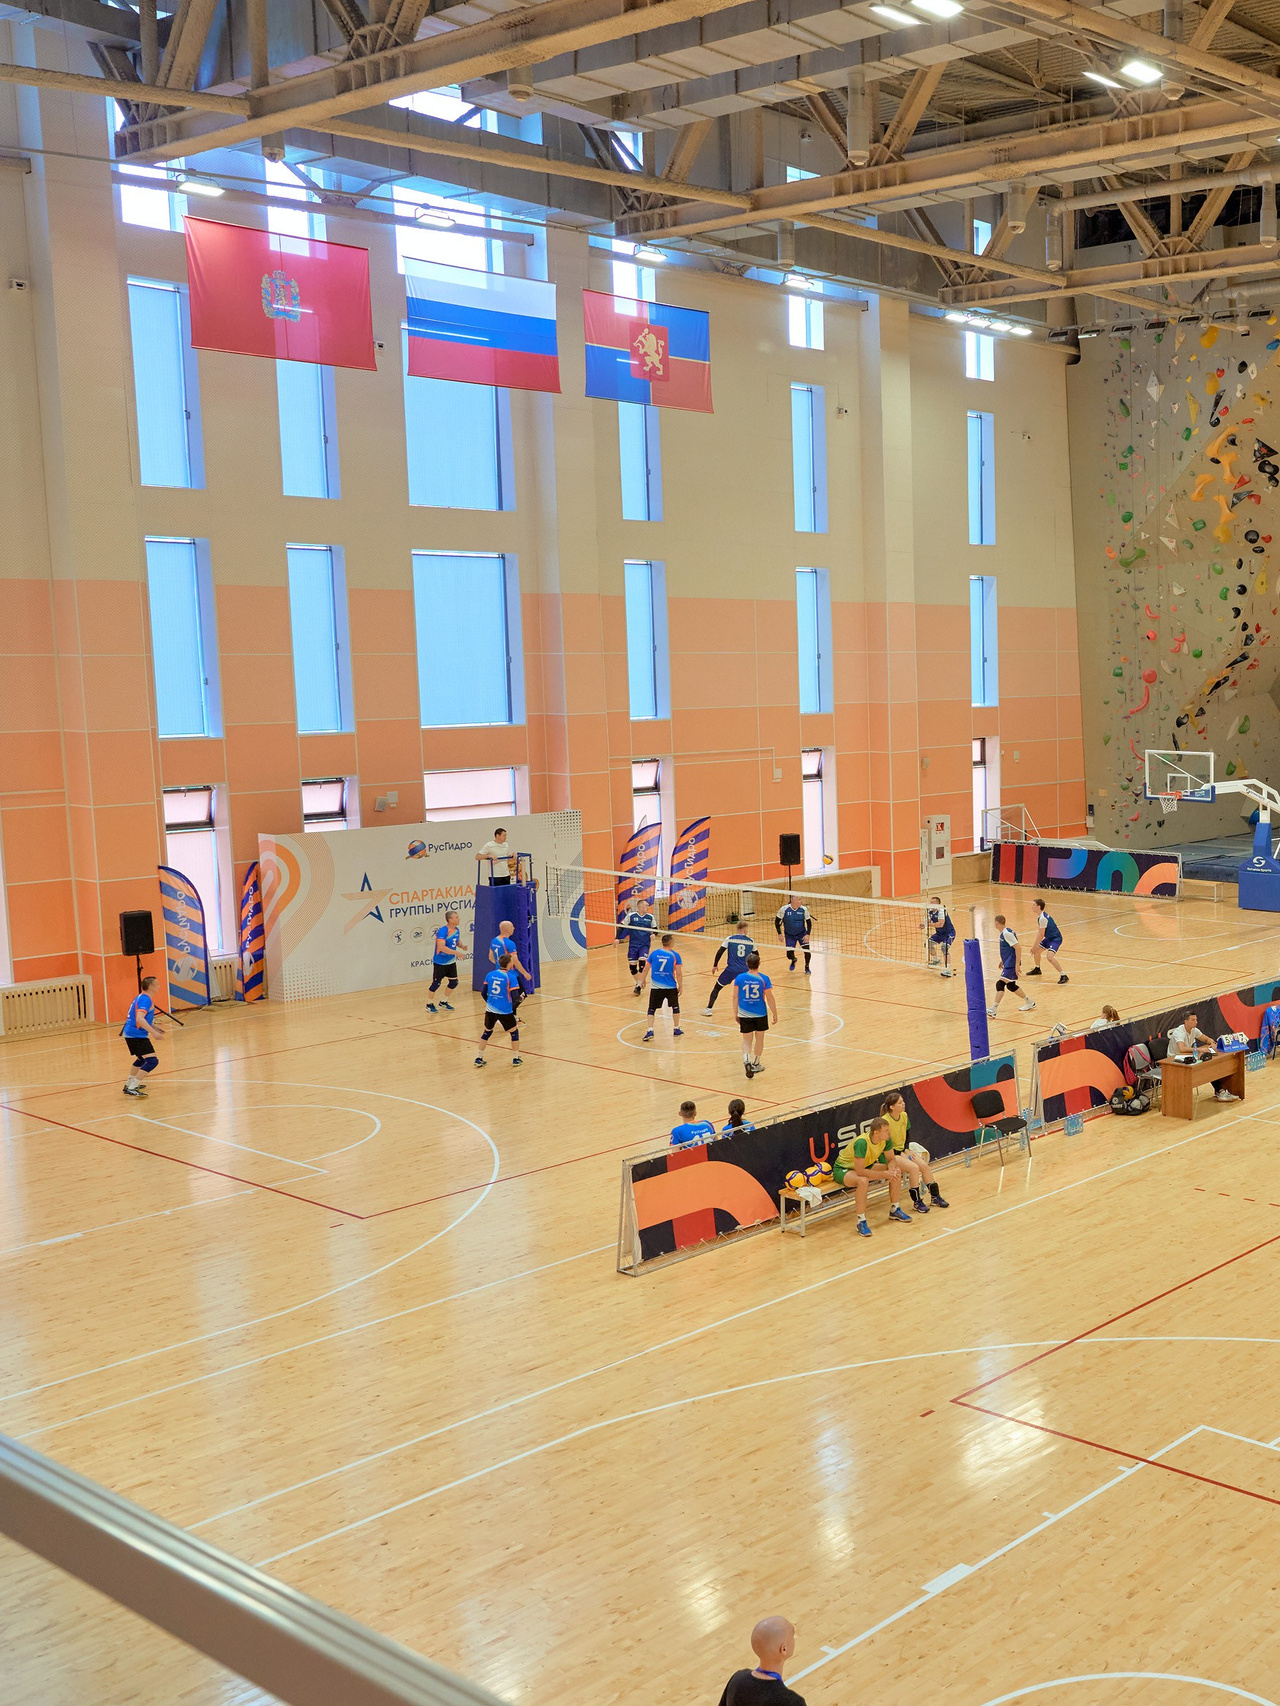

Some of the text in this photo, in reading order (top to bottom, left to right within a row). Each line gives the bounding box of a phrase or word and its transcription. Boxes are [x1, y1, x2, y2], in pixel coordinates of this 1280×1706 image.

[428, 841, 473, 853] РусГидро
[389, 885, 476, 905] СПАРТАКИА
[390, 903, 434, 918] ГРУППЫ
[451, 939, 457, 947] 3
[736, 944, 746, 958] 8
[658, 959, 668, 972] 7
[491, 981, 501, 994] 5
[742, 984, 760, 999] 13
